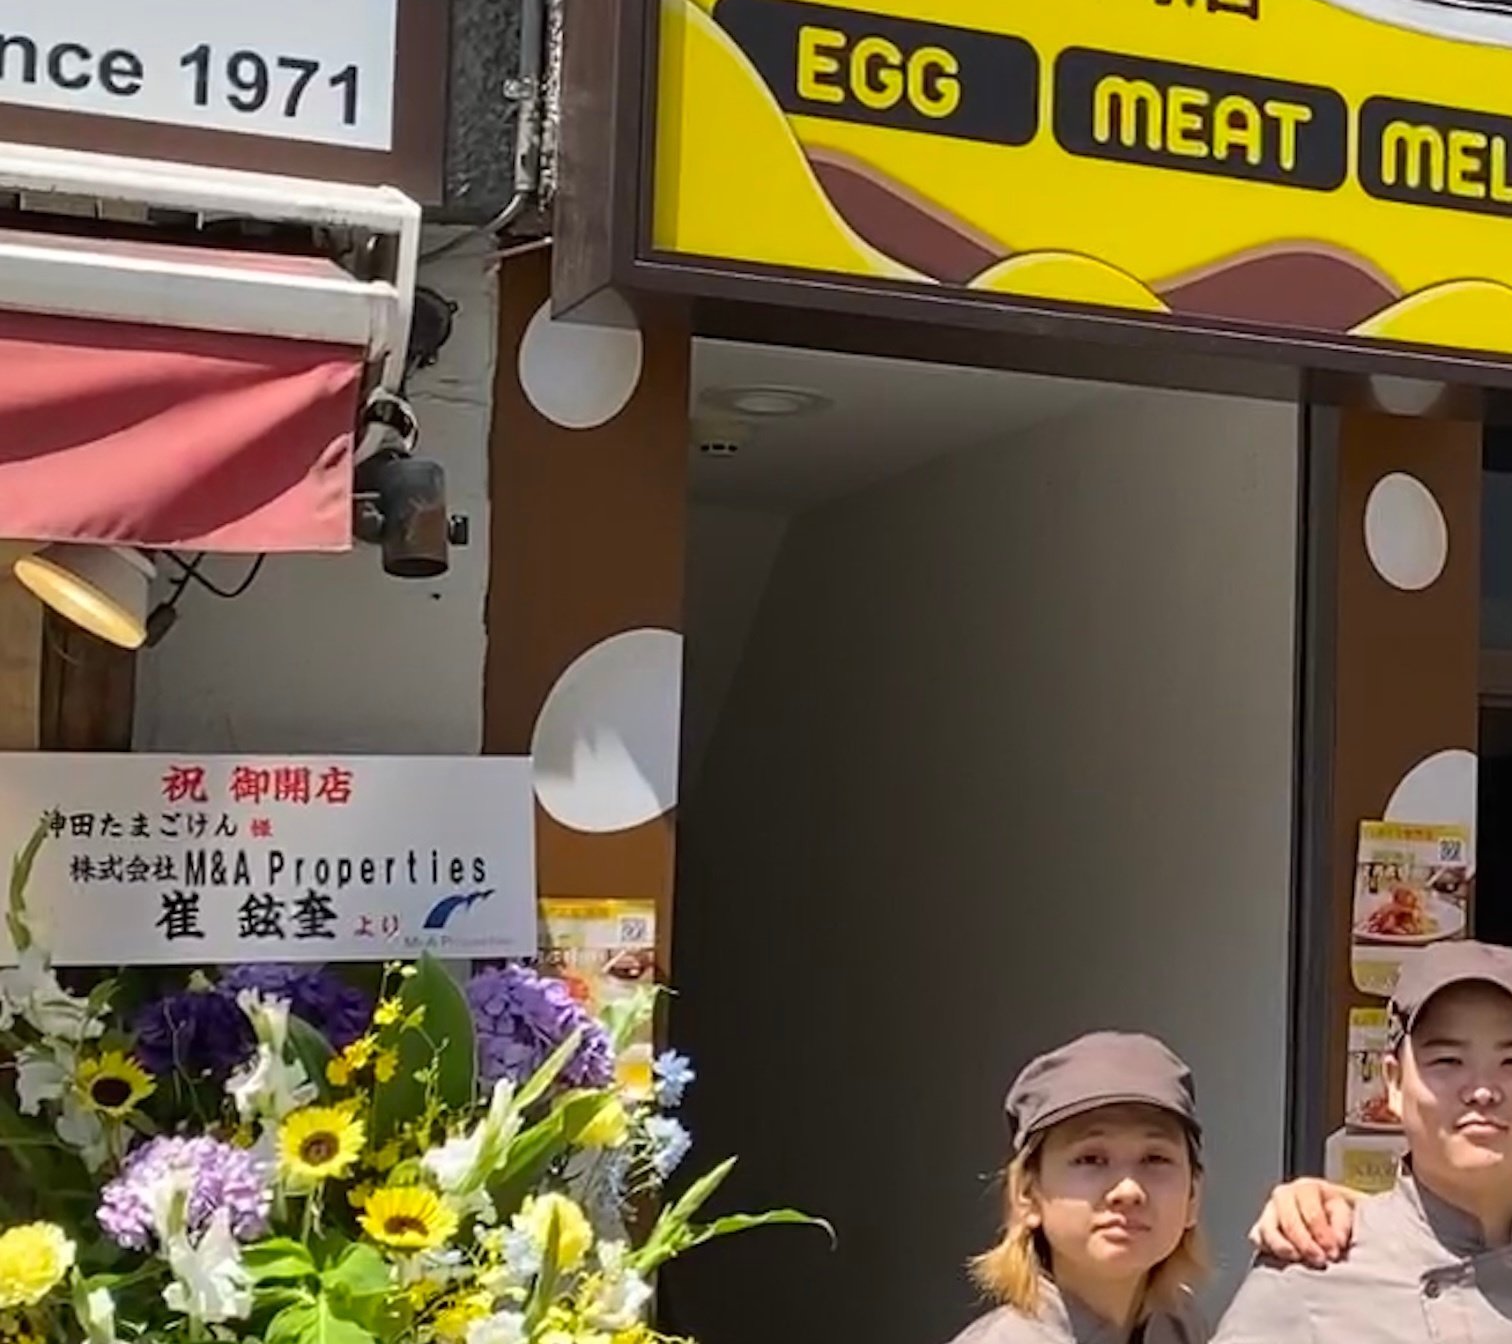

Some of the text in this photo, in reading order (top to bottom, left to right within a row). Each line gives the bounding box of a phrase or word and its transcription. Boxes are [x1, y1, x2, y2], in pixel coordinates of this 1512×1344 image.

[180, 43, 359, 127] 1971
[795, 24, 962, 119] EGG
[1092, 74, 1311, 172] MEAT
[161, 766, 353, 804] 祝 御開店
[44, 810, 272, 838] 神田たまごけん 様
[268, 849, 487, 888] Properties
[353, 915, 399, 938] より
